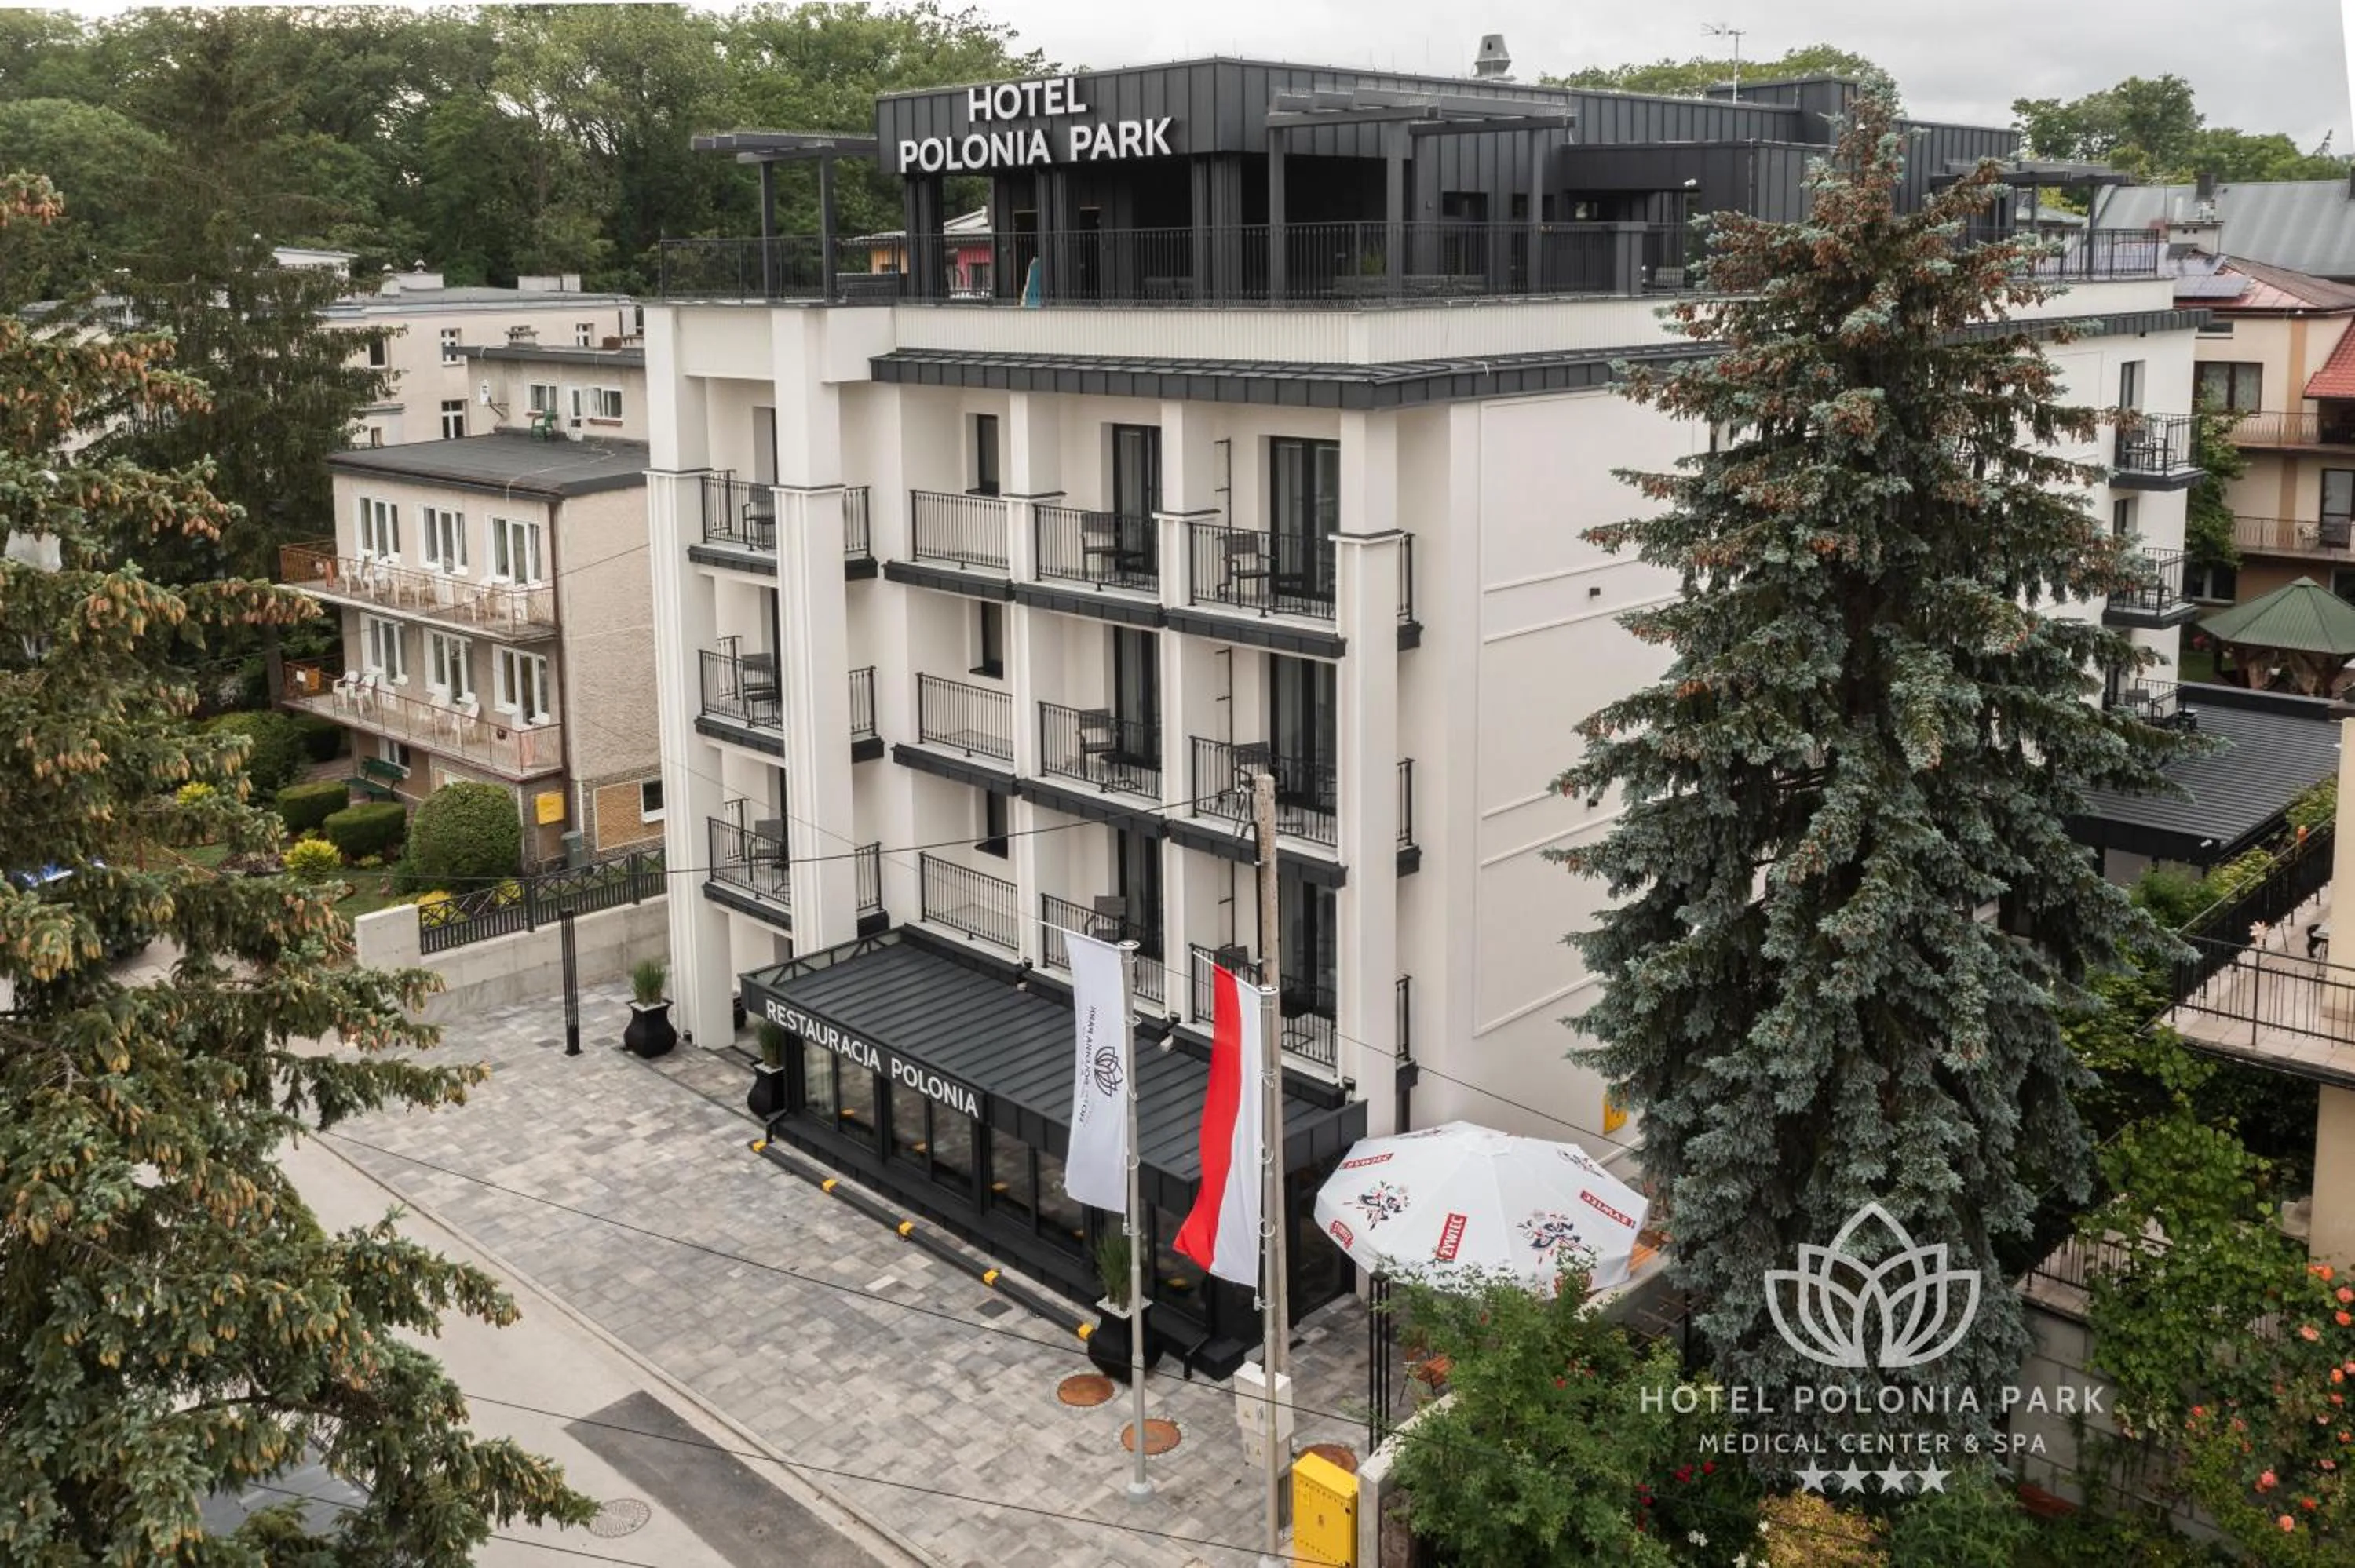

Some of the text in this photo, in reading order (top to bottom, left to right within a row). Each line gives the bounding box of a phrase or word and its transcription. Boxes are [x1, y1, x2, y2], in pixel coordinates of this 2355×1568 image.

[968, 78, 1087, 122] HOTEL
[900, 116, 1172, 173] POLONIA PARK
[765, 999, 979, 1118] RESTAURACJA POLONIA
